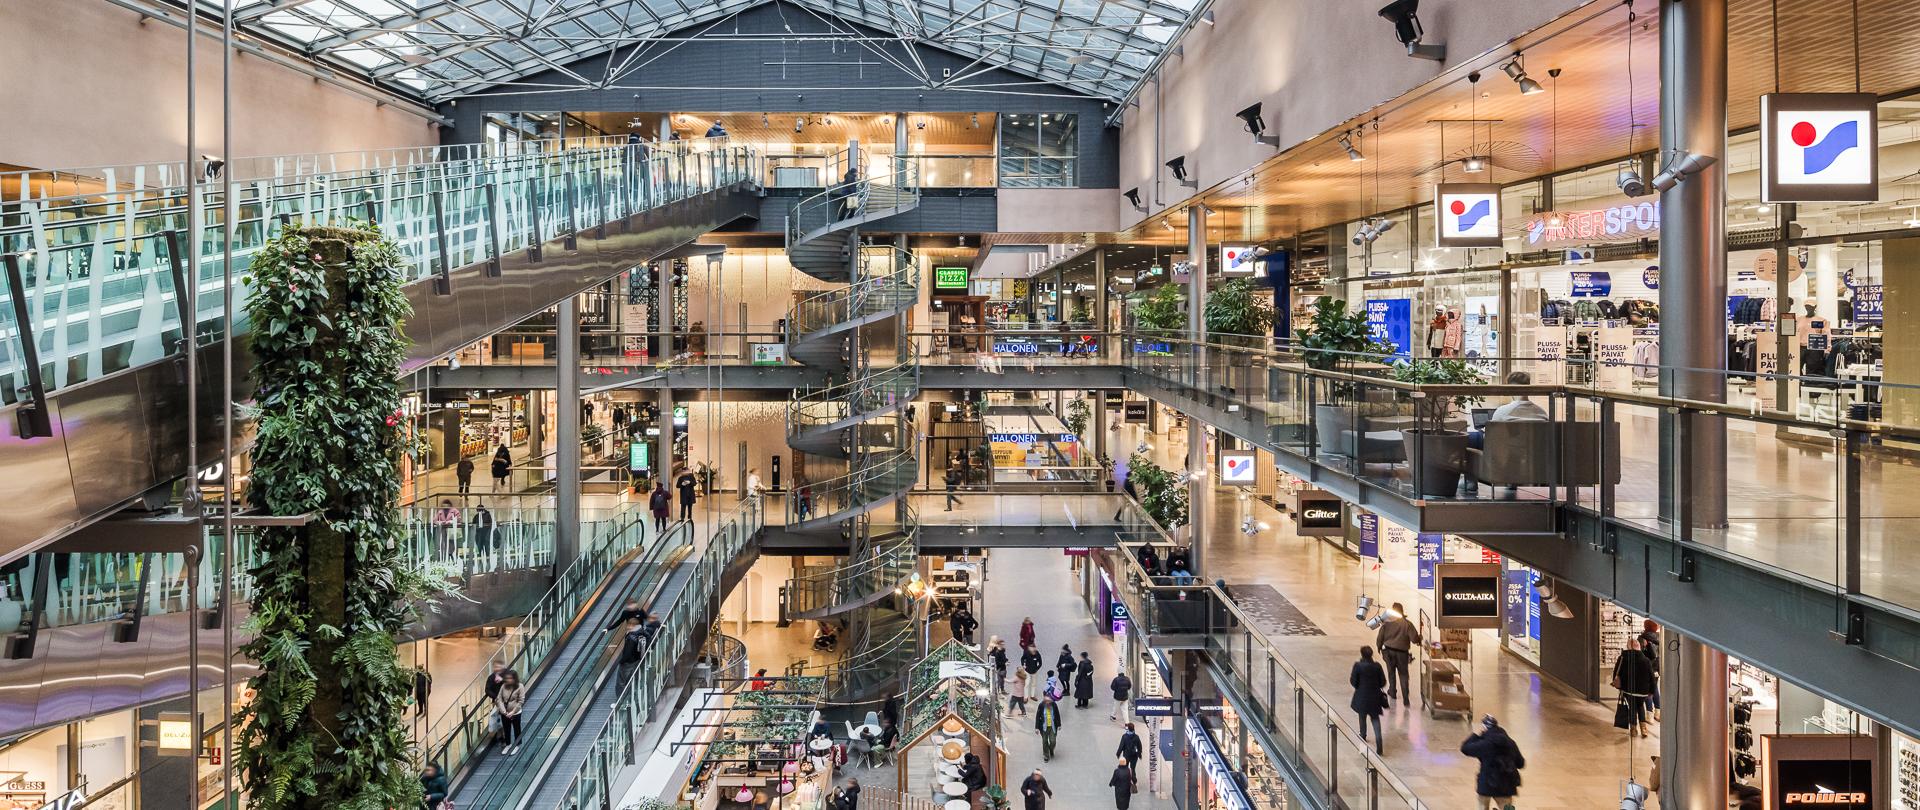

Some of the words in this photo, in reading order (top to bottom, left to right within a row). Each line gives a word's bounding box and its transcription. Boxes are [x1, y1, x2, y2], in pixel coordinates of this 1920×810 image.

[1368, 302, 1389, 312] PLUSSA-
[1368, 312, 1385, 322] PÄIVÄT
[1368, 323, 1389, 338] -20%
[993, 344, 1038, 353] HALONEN
[1538, 353, 1562, 362] 20%
[1760, 352, 1795, 360] PLUA-
[1602, 358, 1627, 367] 20%
[992, 434, 1037, 442] HALONEN
[1304, 509, 1339, 519] Glitter
[1452, 593, 1495, 601] KULTA-AIKA
[1785, 792, 1867, 804] POWER
